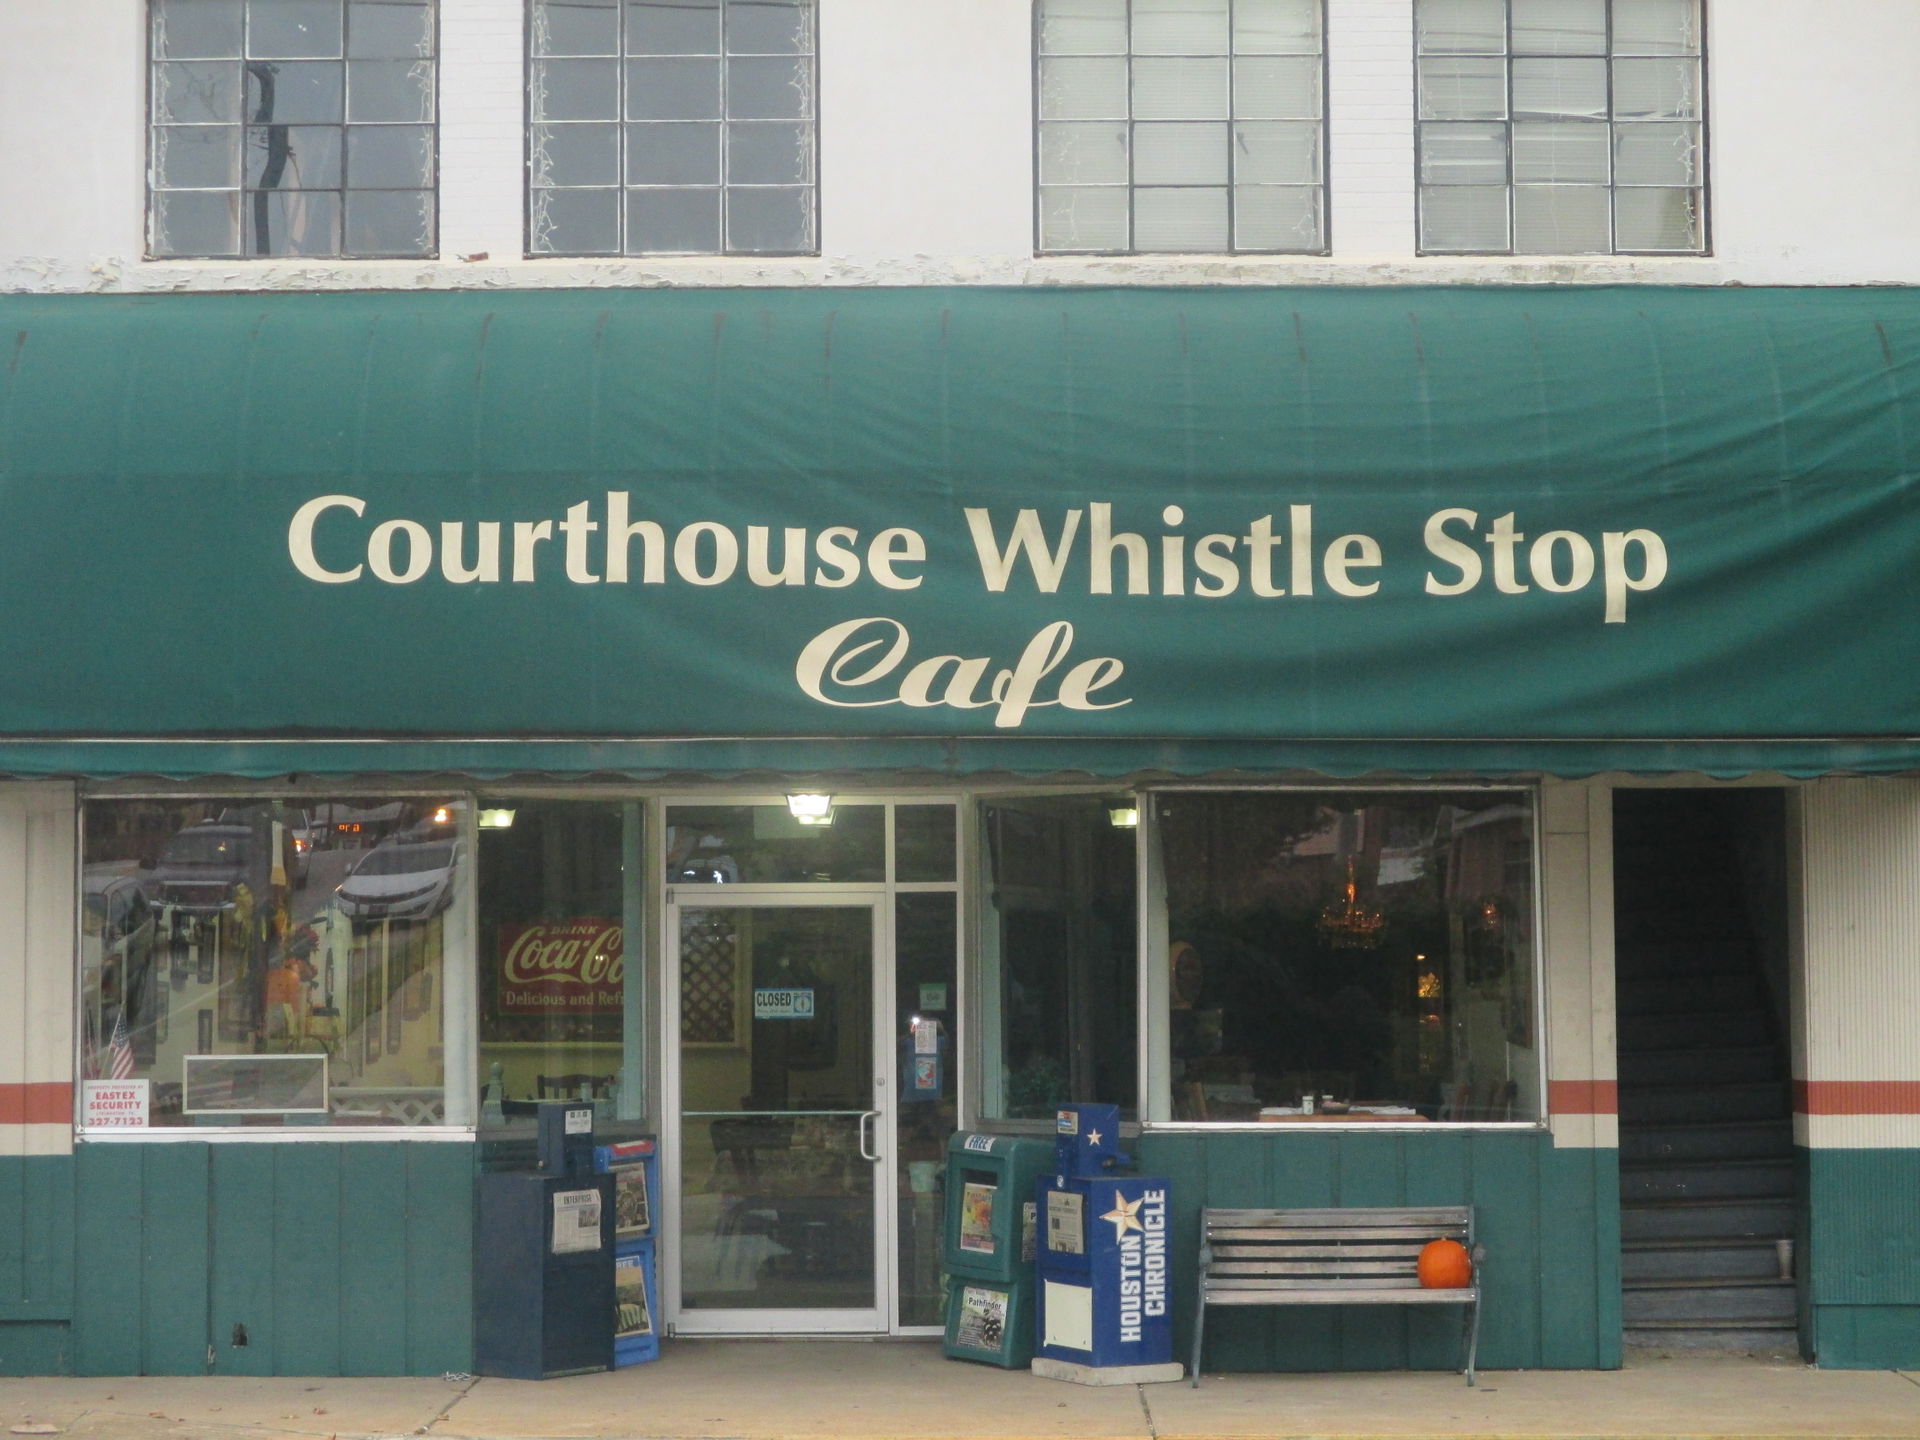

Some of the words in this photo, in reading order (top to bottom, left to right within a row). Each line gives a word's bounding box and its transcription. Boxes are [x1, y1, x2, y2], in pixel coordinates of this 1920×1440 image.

[288, 491, 927, 590] Courthouse
[963, 501, 1383, 598] Whistle
[1423, 507, 1669, 624] Stop
[795, 617, 1133, 728] Cafe
[551, 926, 598, 934] DRINK
[506, 991, 566, 1006] Delicious
[570, 993, 594, 1006] and
[756, 992, 791, 1006] CLOSED
[96, 1092, 136, 1100] EASTEX
[88, 1101, 142, 1110] SECURITY
[88, 1116, 144, 1126] 327-7123
[968, 1135, 991, 1150] FREE
[563, 1194, 592, 1205] ENTERPRISE
[1144, 1189, 1166, 1316] CHRONICLE
[1120, 1234, 1142, 1342] HOUSTON
[968, 1297, 1002, 1310] Pathfinder
